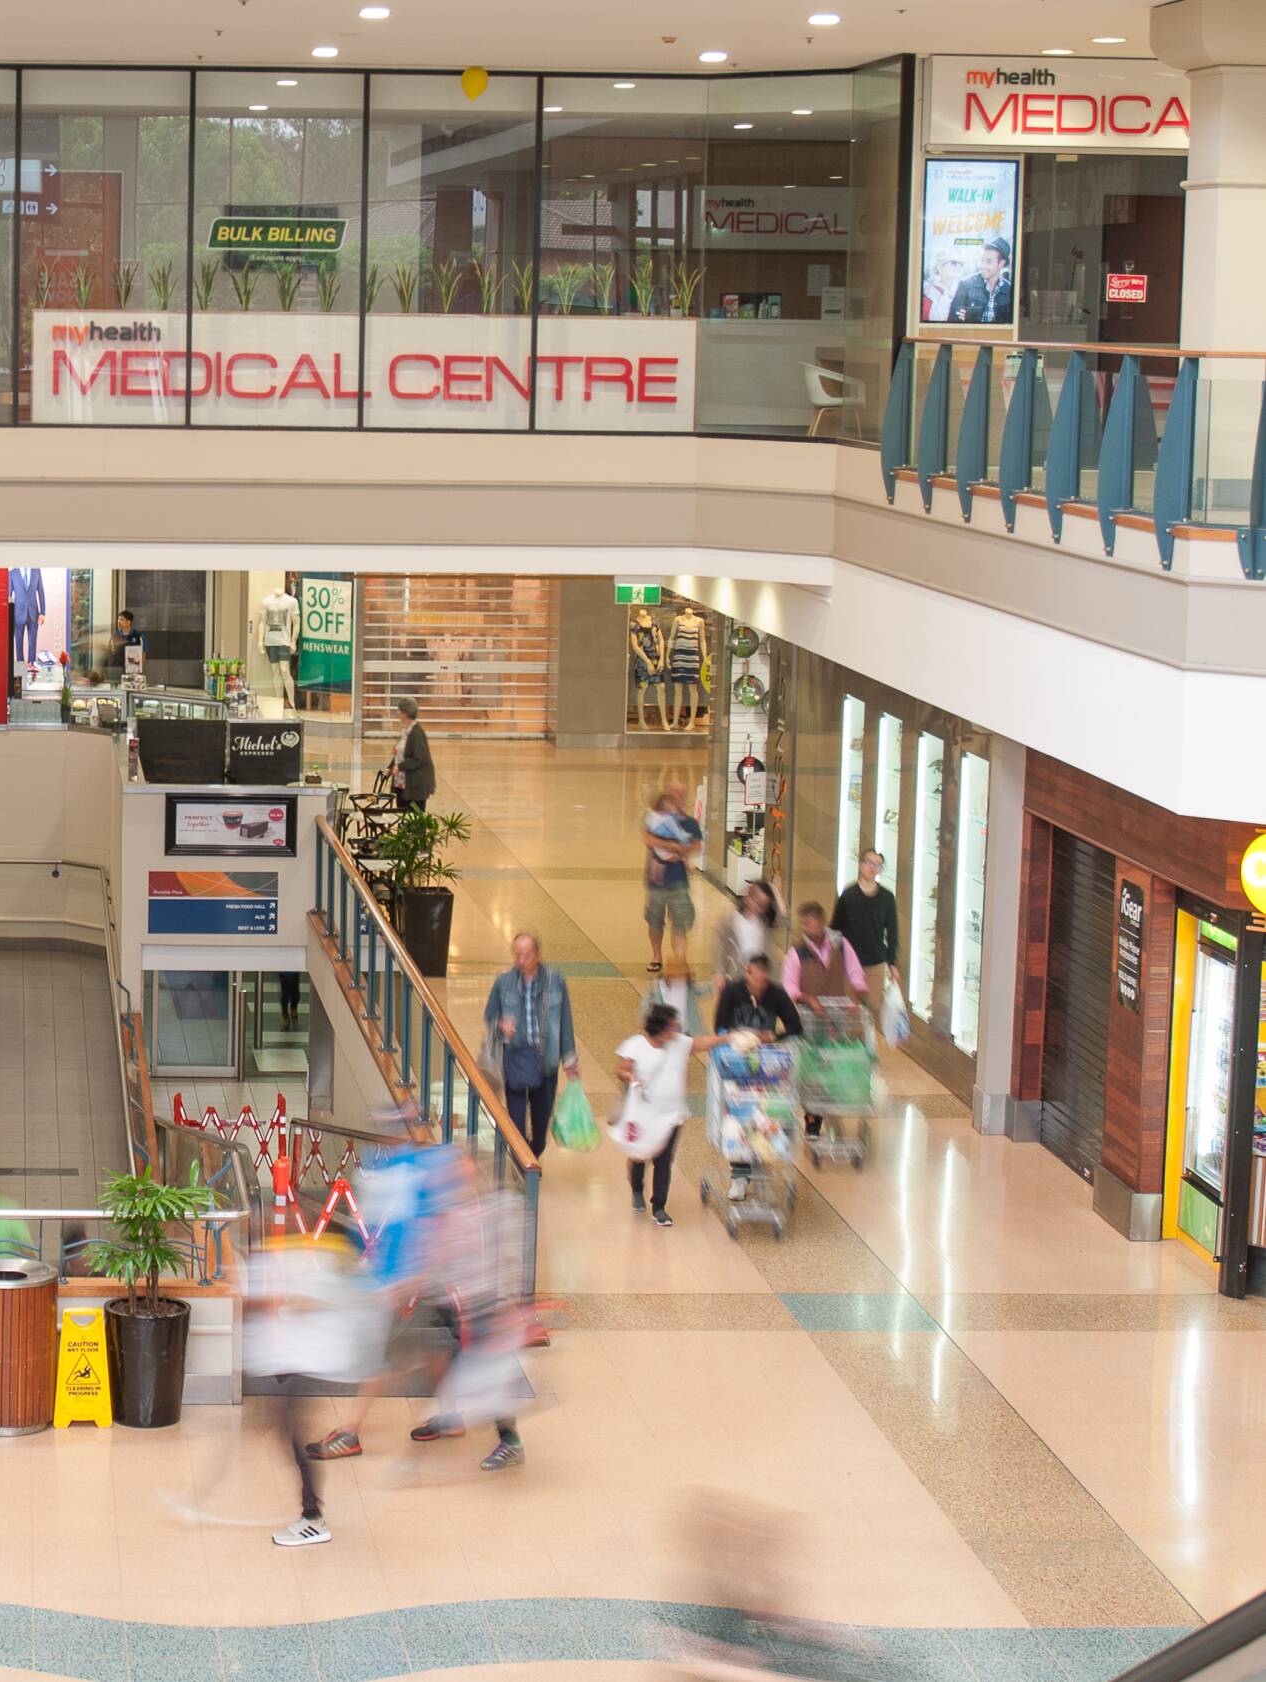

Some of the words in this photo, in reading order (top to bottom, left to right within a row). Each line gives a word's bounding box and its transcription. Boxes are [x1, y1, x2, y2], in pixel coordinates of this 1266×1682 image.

[966, 68, 1056, 88] myhealth
[964, 92, 1190, 135] MEDICA
[705, 198, 755, 210] myhealth
[948, 188, 994, 203] WALK-IN
[704, 211, 849, 236] MEDICAL
[217, 226, 263, 241] BULK
[267, 227, 337, 243] BILLING
[1109, 289, 1144, 300] CLOSED
[51, 321, 162, 346] myhealth
[51, 349, 373, 400] MEDICAL
[388, 353, 679, 404] CENTRE
[306, 586, 344, 609] 30%
[306, 610, 345, 634] OFF
[302, 641, 350, 655] MENSWEAR
[232, 735, 282, 751] Michel's
